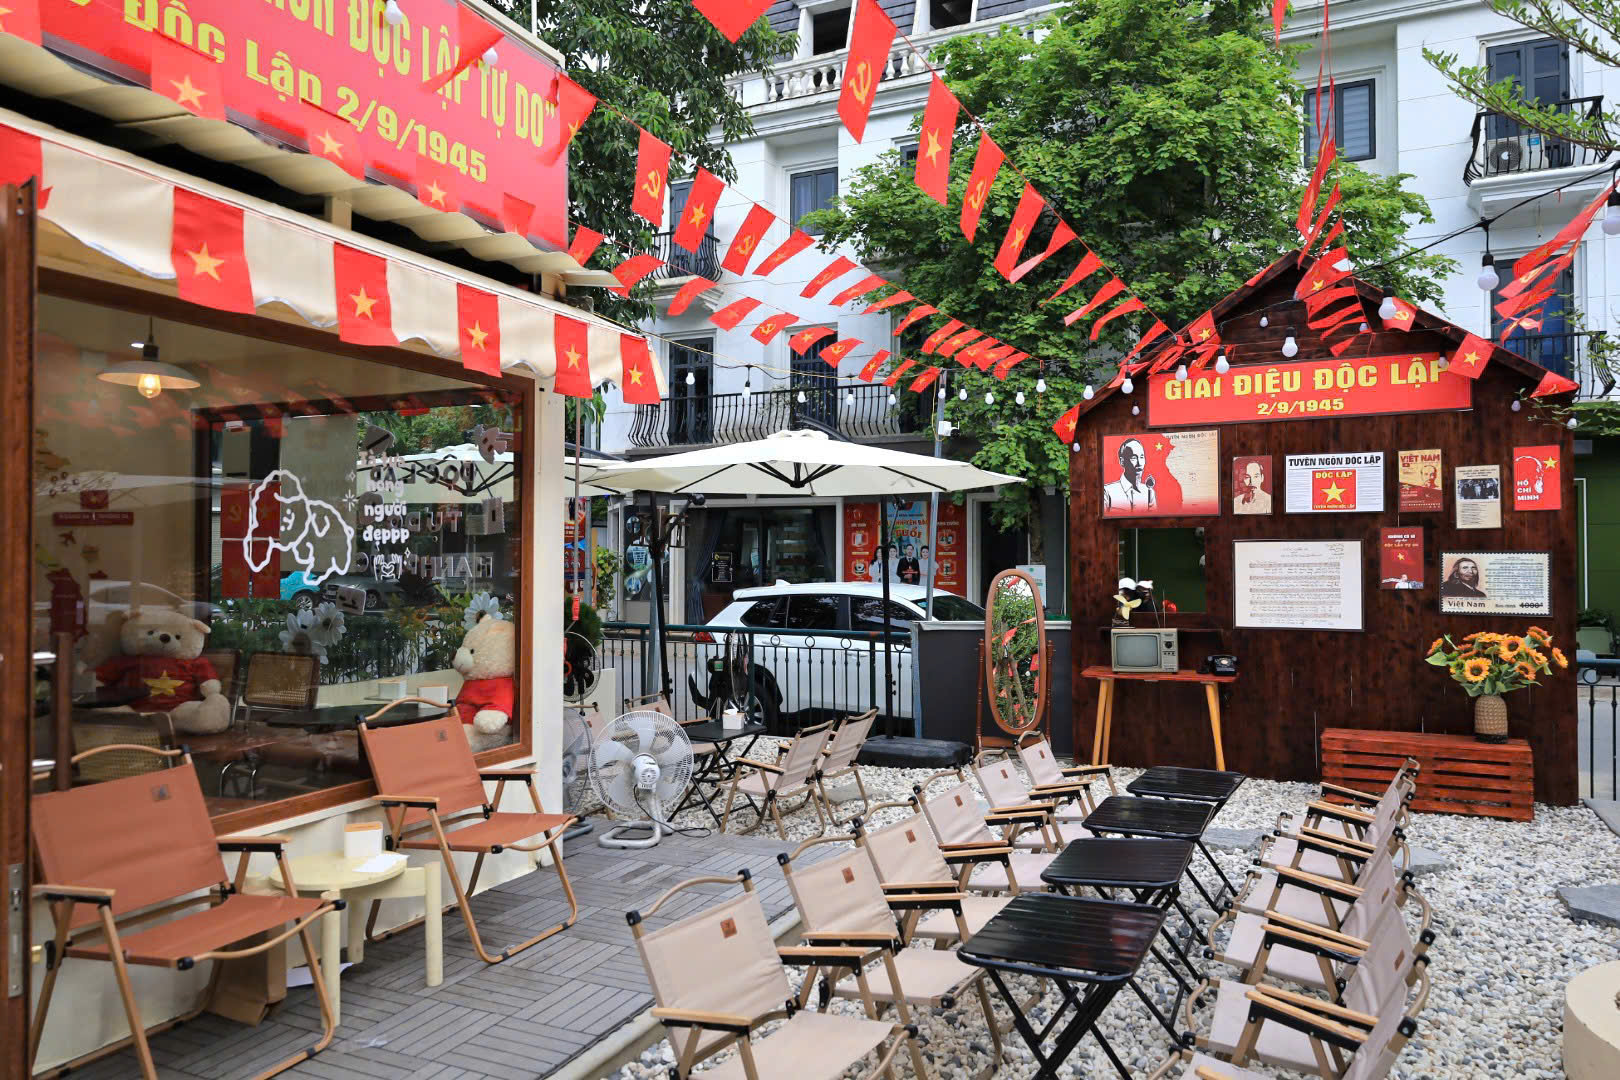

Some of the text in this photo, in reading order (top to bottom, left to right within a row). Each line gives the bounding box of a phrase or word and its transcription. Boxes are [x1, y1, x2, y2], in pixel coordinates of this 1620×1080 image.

[337, 86, 487, 183] 2/9/1945
[1165, 358, 1449, 400] GIAI ĐIỆU ĐỘC LẬP
[1257, 398, 1345, 415] 2/9/1945
[1288, 456, 1316, 467] TUYÊN
[1318, 455, 1343, 466] NGÔN
[1421, 453, 1440, 462] NAM
[1448, 600, 1464, 608] Việt
